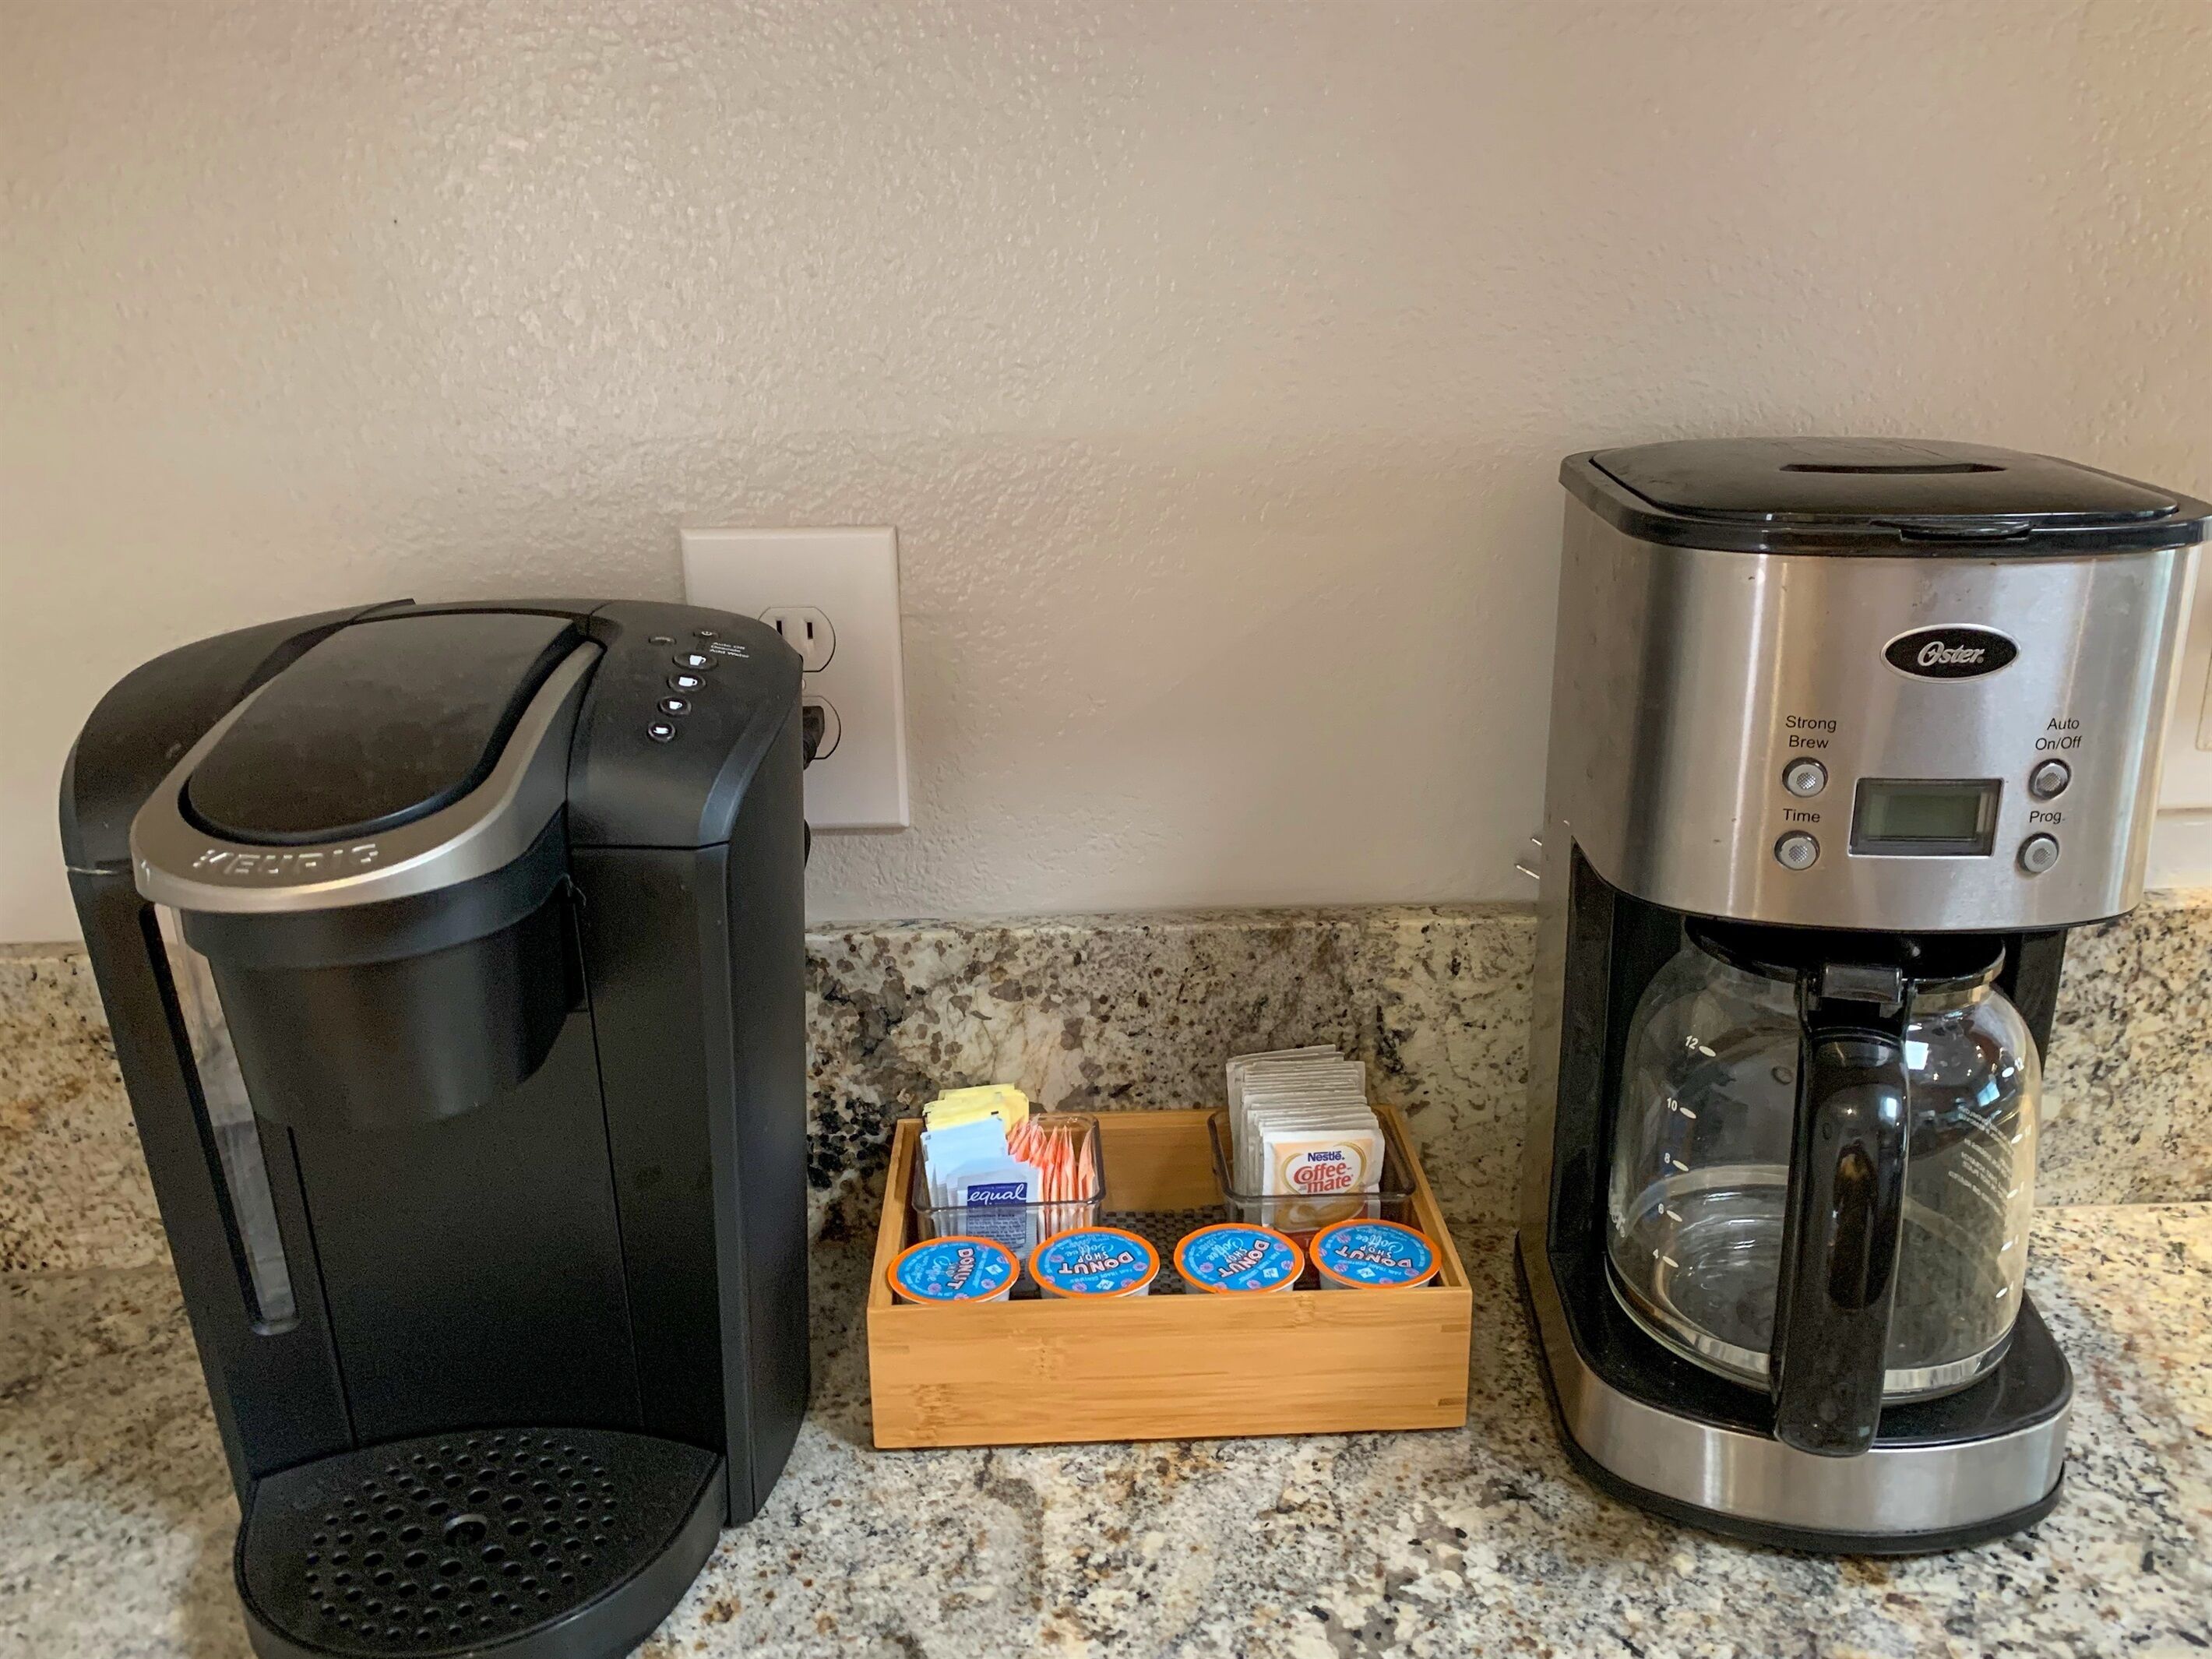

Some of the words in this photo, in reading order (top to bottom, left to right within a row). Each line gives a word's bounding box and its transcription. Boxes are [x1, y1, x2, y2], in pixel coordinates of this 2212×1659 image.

[1918, 641, 1983, 666] Oster
[1785, 715, 1837, 734] Strong
[2047, 717, 2080, 731] Auto
[1788, 735, 1830, 749] Brew
[2034, 735, 2083, 751] On/Off
[1782, 808, 1821, 823] Time
[192, 844, 379, 875] KEURIG
[1685, 1035, 1699, 1050] 12
[1667, 1097, 1678, 1111] 10
[1308, 1150, 1342, 1162] Nestlé
[1664, 1153, 1671, 1164] 8
[1308, 1175, 1352, 1193] mate
[967, 1183, 1027, 1205] equal
[1355, 1234, 1404, 1253] Coffee
[1360, 1245, 1392, 1258] SHOP
[1077, 1251, 1109, 1263] SHOP
[1217, 1239, 1271, 1278] DONUT
[1224, 1247, 1249, 1263] SHOP
[1334, 1245, 1413, 1268] DONUT
[1652, 1249, 1659, 1259] 4
[947, 1247, 975, 1290] DONUT
[1058, 1251, 1136, 1275] DONUT
